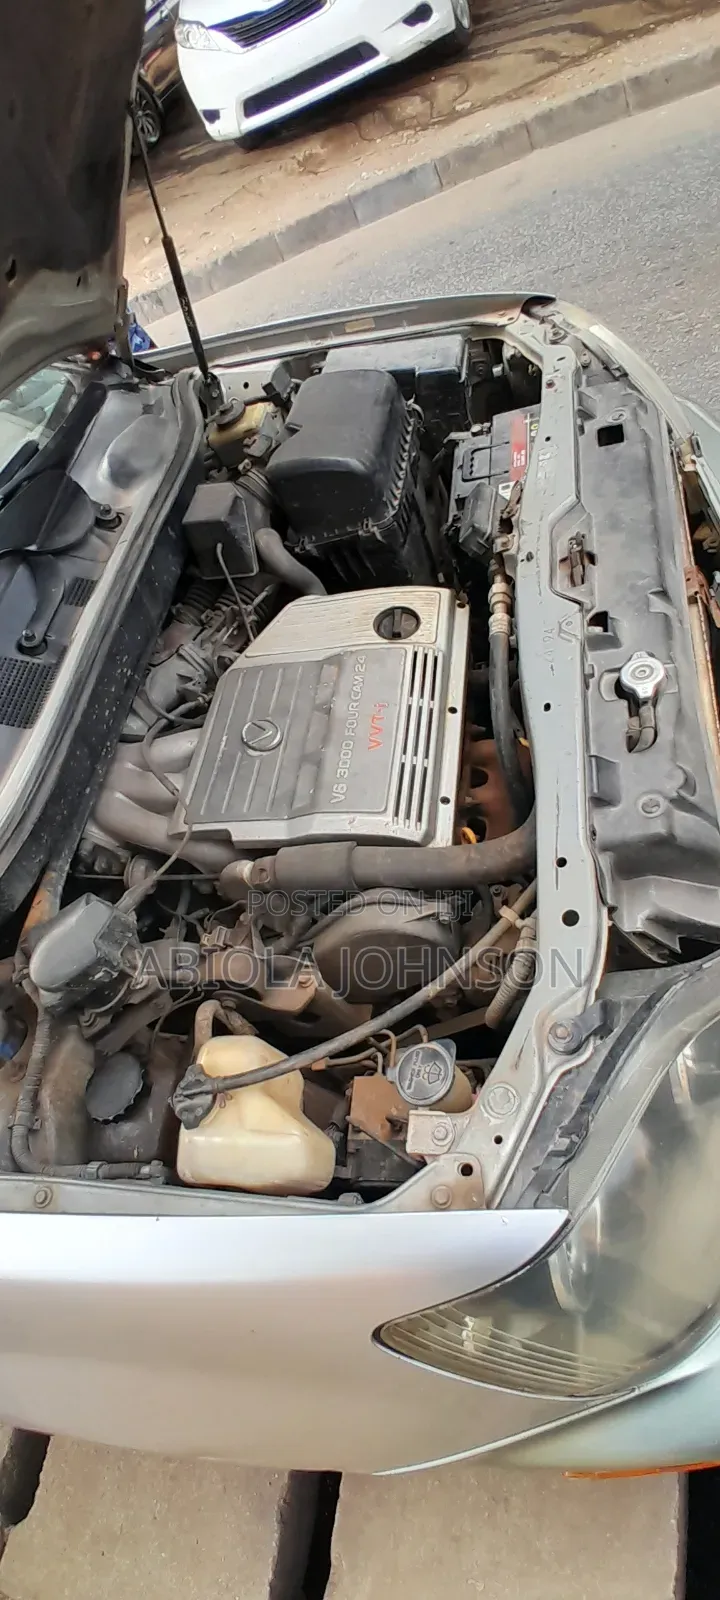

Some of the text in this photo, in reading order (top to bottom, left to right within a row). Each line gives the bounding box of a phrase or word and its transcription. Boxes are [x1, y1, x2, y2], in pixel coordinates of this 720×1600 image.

[329, 654, 367, 804] V6 3000 FOUR CAM 24
[367, 702, 389, 751] VVT-i
